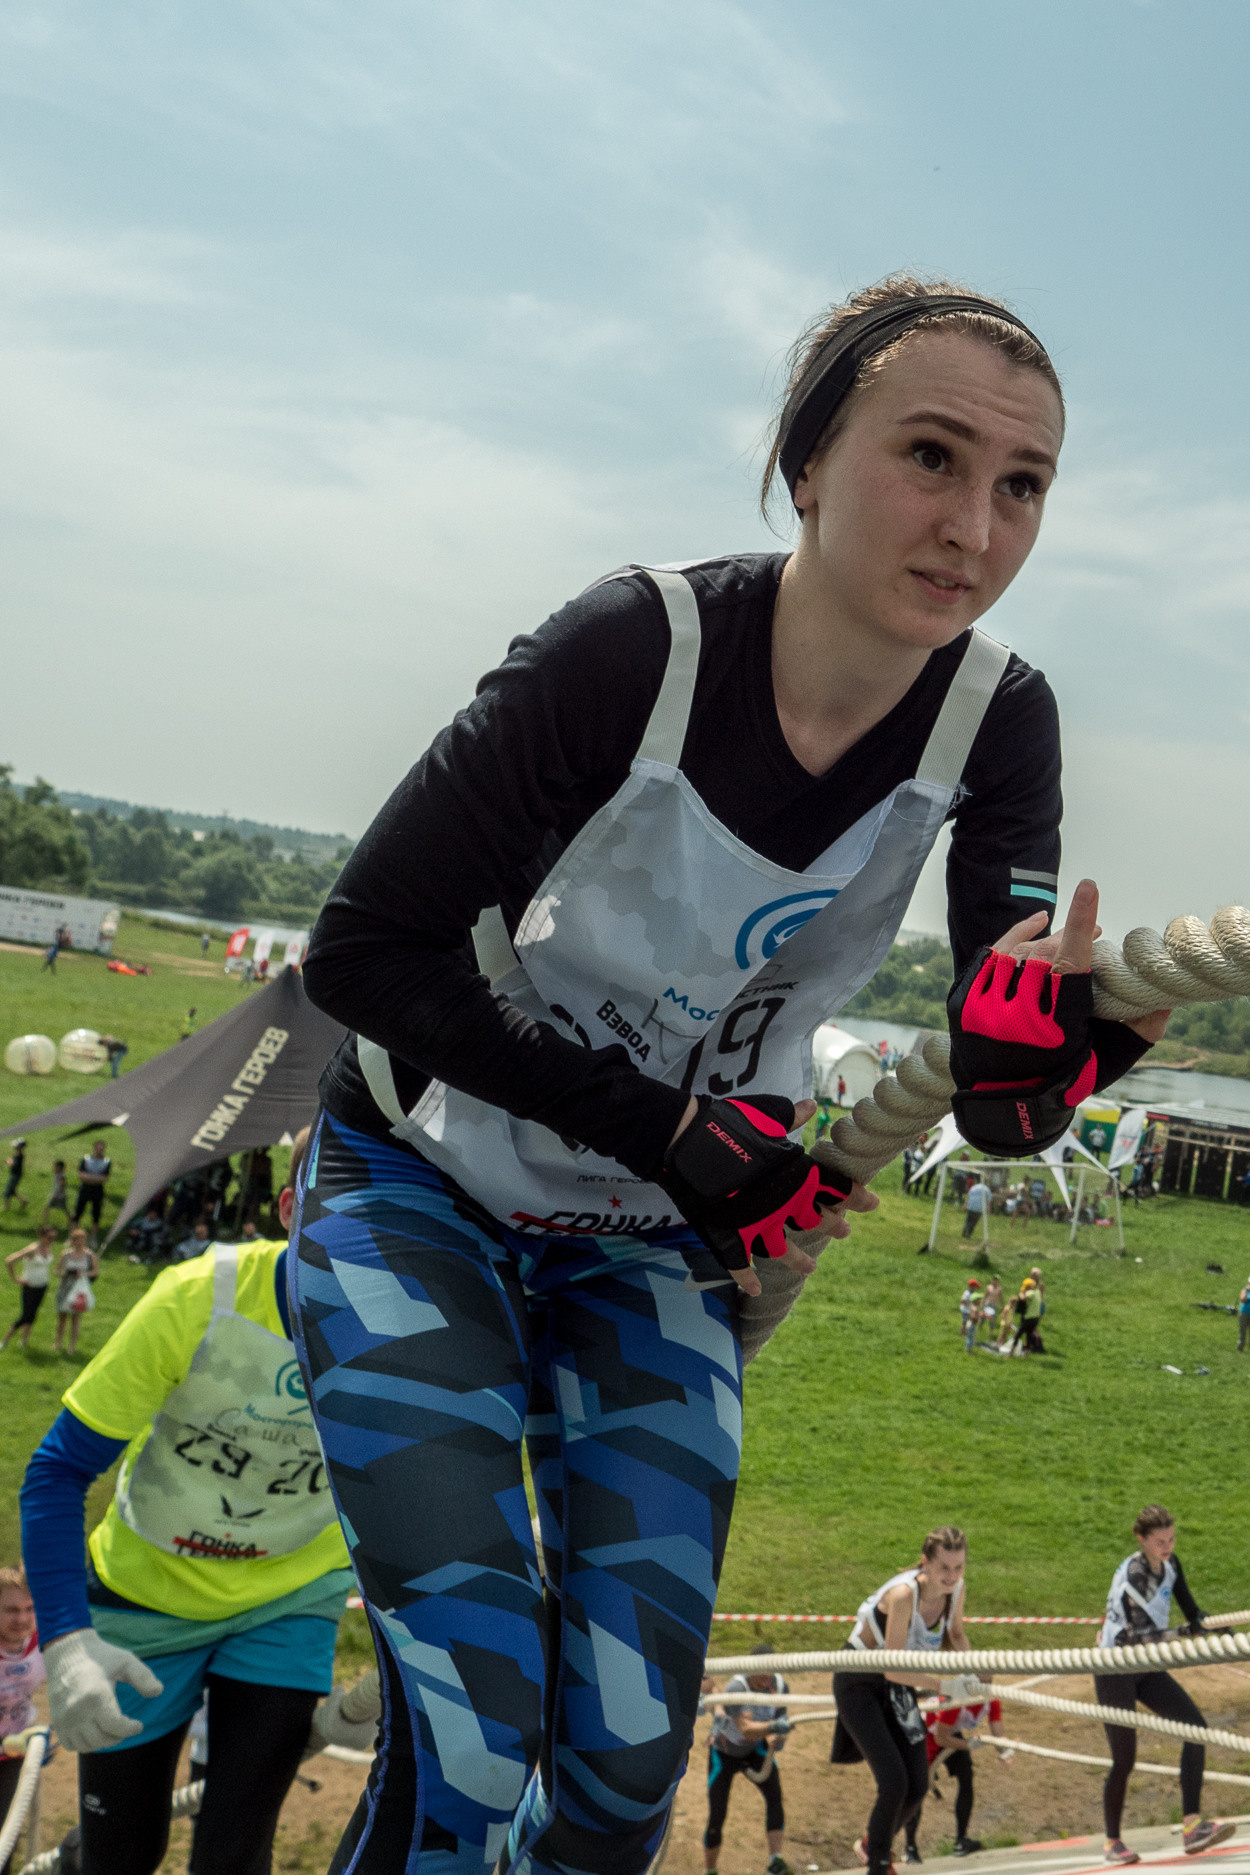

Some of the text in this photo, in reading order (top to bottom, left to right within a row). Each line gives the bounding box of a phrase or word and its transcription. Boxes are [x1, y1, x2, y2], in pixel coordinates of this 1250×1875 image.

[662, 987, 720, 1021] Мос
[734, 981, 799, 1000] СТНИК
[596, 999, 652, 1063] ВЗВОД
[189, 1026, 289, 1152] ГОНКА ГЕРОЕВ
[1015, 1101, 1035, 1140] DEMIX
[706, 1120, 753, 1164] DEMIX
[576, 1174, 650, 1185] ЛИГА ГЕРО
